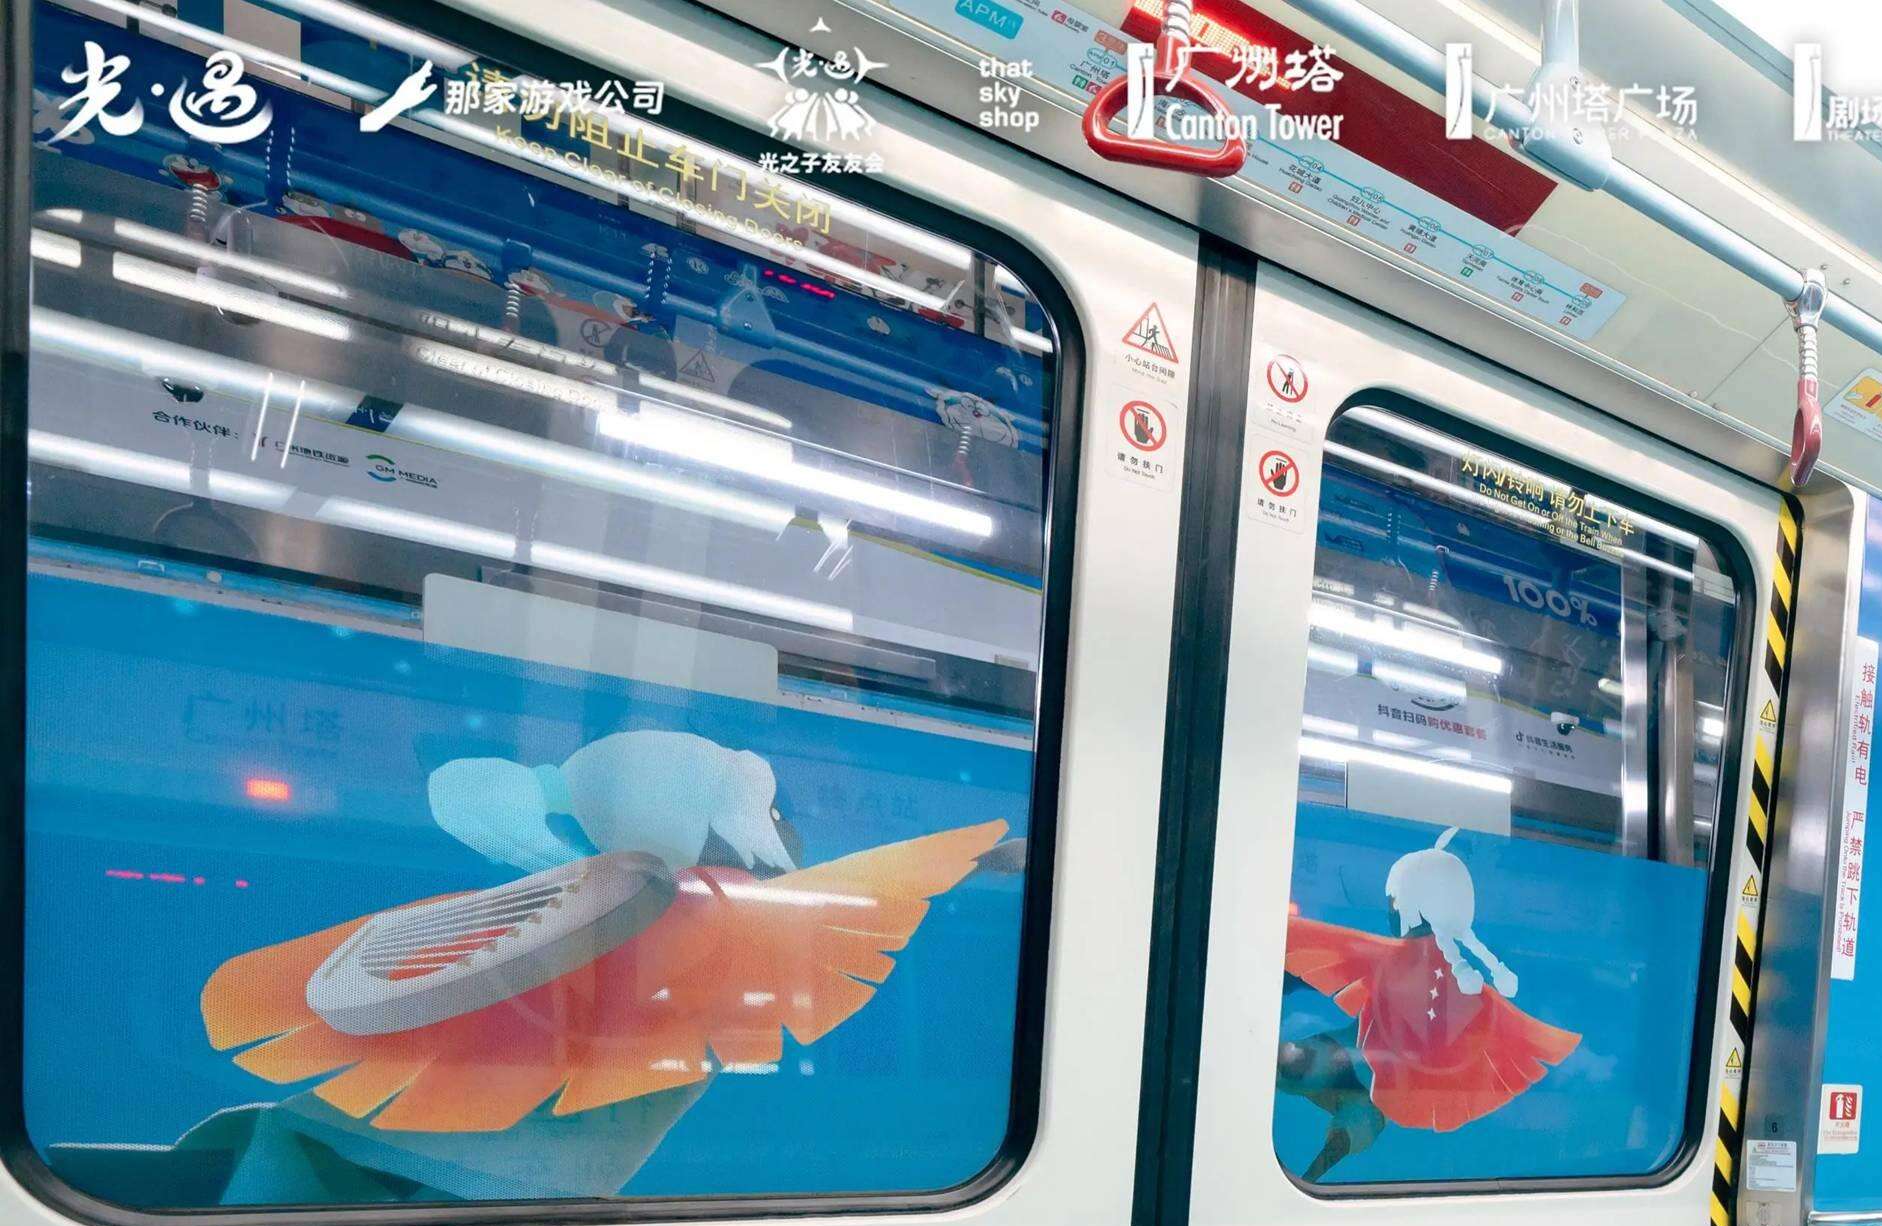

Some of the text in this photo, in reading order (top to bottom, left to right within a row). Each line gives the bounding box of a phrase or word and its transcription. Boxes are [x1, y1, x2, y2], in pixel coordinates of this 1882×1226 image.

[495, 124, 558, 161] Keep
[398, 469, 439, 485] MEDIA
[1479, 483, 1493, 497] Do
[1494, 487, 1510, 503] Not
[1511, 494, 1527, 510] Get
[1527, 502, 1541, 515] On
[1541, 508, 1551, 518] or
[1565, 516, 1578, 529] the
[1579, 522, 1600, 538] Train
[1503, 574, 1599, 629] 100%
[1855, 662, 1876, 787] 接触轨有电
[1841, 810, 1865, 957] 严禁跳下轨道
